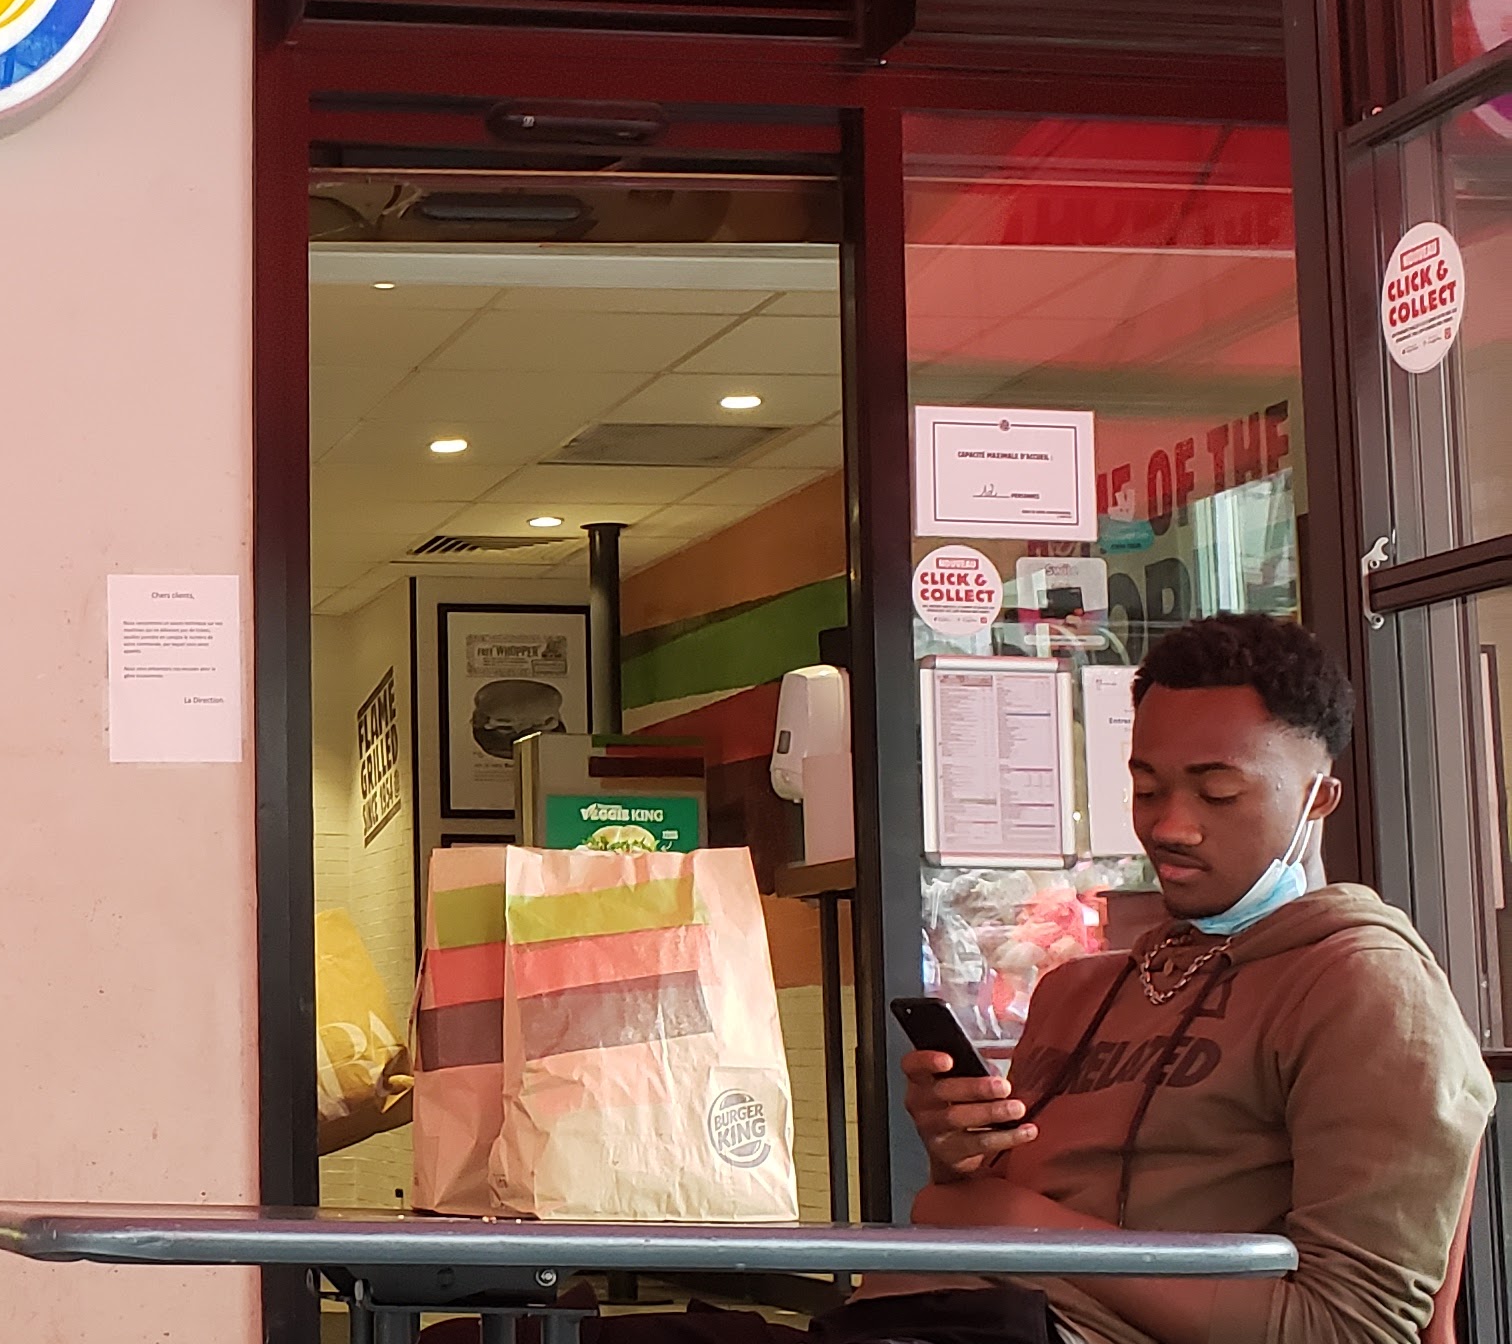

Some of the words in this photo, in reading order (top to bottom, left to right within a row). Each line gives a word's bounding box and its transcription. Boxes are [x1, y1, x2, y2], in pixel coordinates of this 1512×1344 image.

[1388, 264, 1432, 302] CLICK
[1436, 259, 1449, 282] &
[1389, 280, 1457, 327] COLLECT
[920, 572, 970, 586] CLICK
[974, 574, 986, 586] &
[920, 588, 995, 603] COLLECT
[184, 696, 191, 704] La
[358, 678, 396, 760] FLAME
[360, 723, 398, 800] GRILLED
[631, 809, 664, 822] KING
[714, 1103, 764, 1131] BURGER
[717, 1117, 766, 1152] KING
